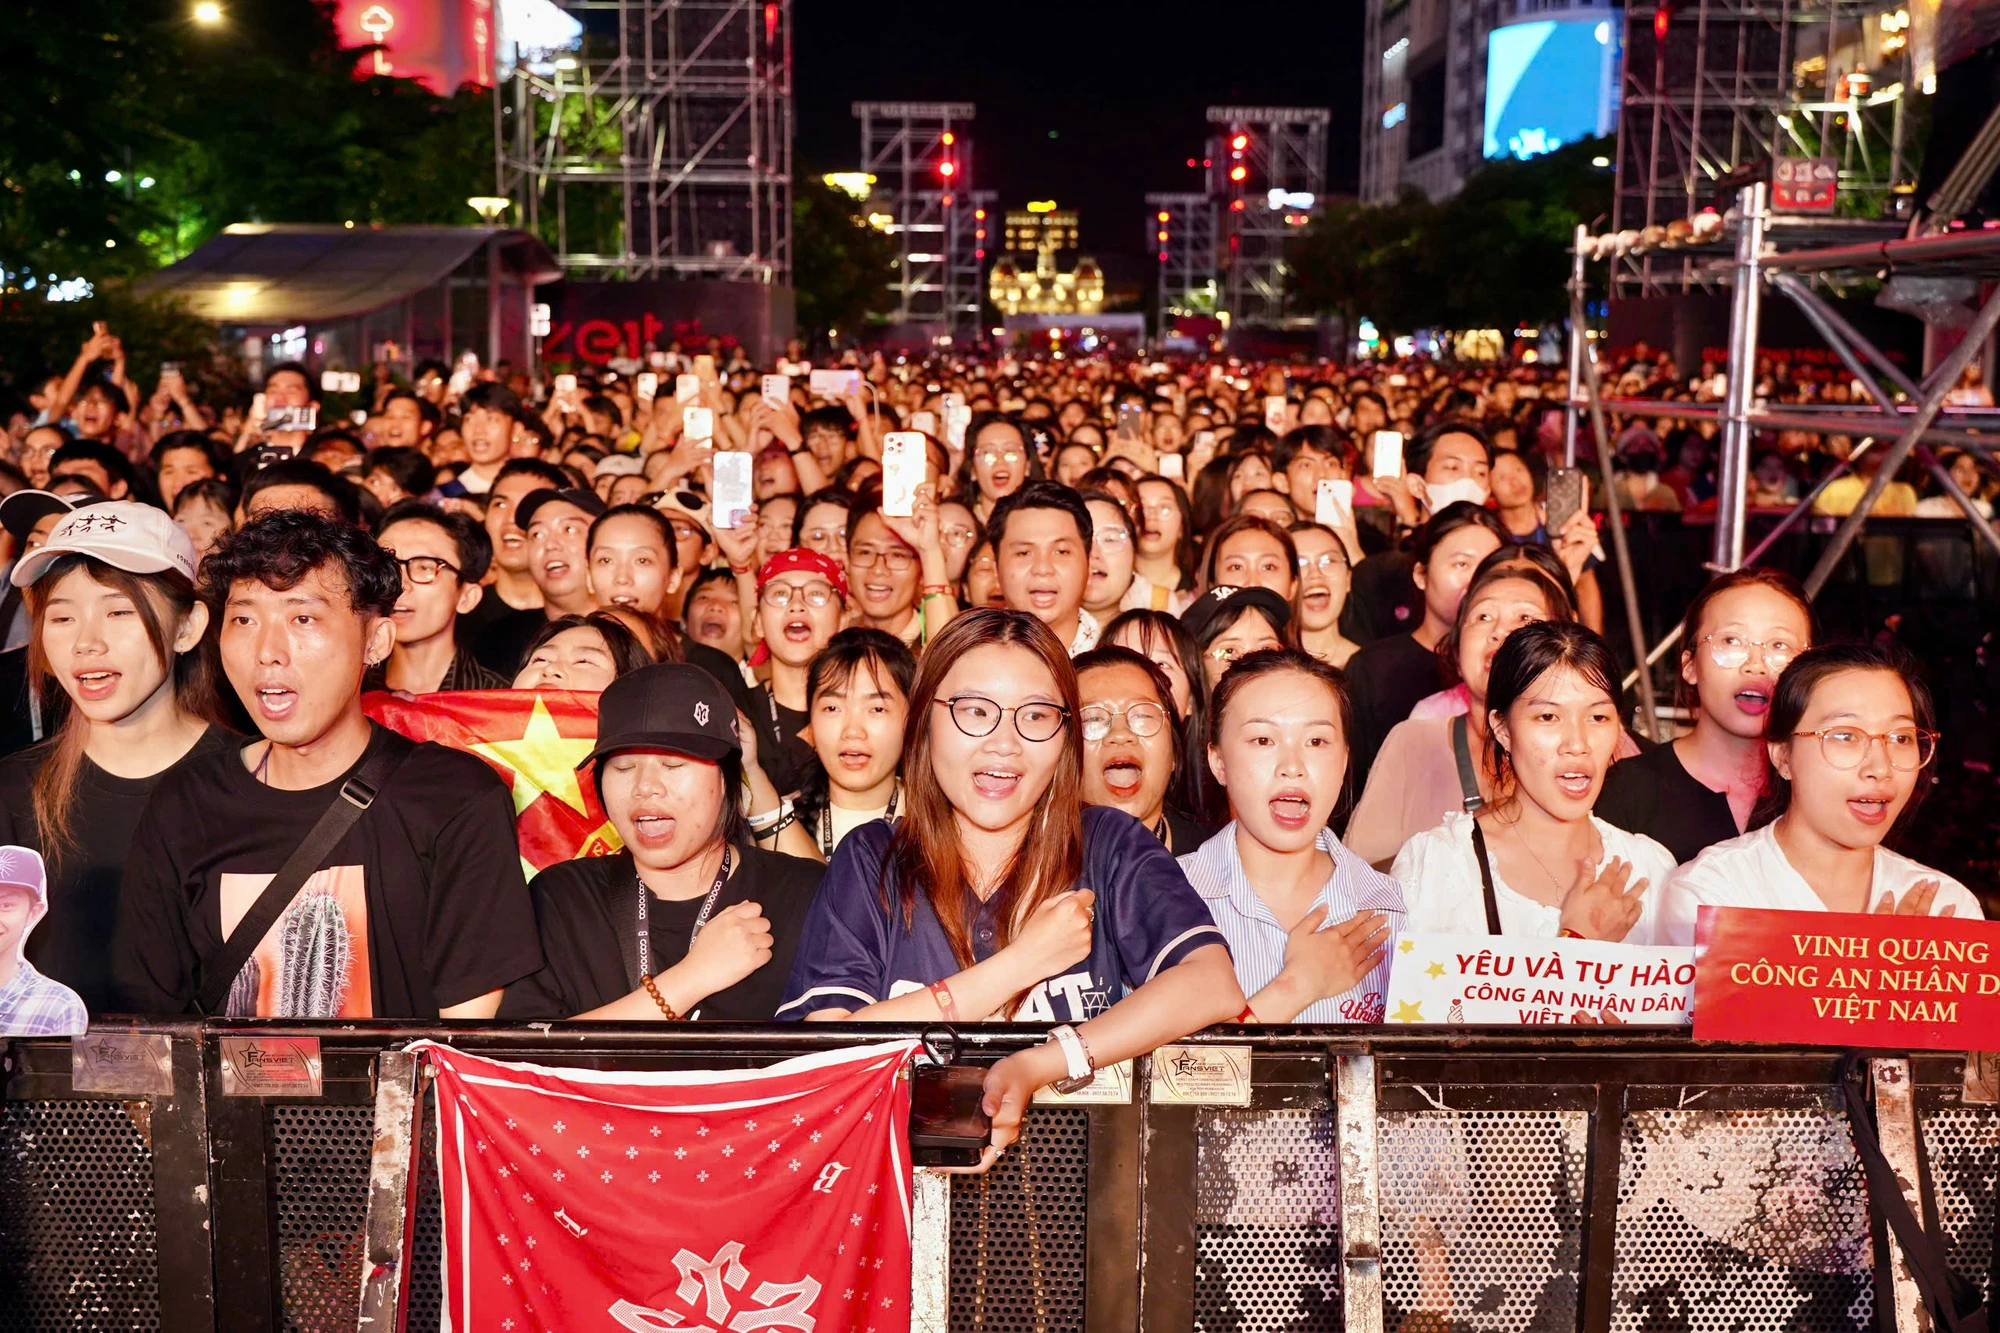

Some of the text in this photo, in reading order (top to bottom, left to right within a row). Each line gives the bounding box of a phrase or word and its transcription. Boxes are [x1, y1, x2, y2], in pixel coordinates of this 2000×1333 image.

[1791, 934, 1989, 966] VINH QUANG
[1456, 949, 1696, 991] YÊU VÀ TỰ HÀO
[1730, 957, 2000, 995] CÔNG AN NHÂN D
[1463, 982, 1687, 1014] CÔNG AN NHÂN DÂN
[1812, 992, 1958, 1024] VIỆT NAM
[247, 1051, 295, 1063] FANSVIET
[1179, 1059, 1226, 1072] FANSVIET
